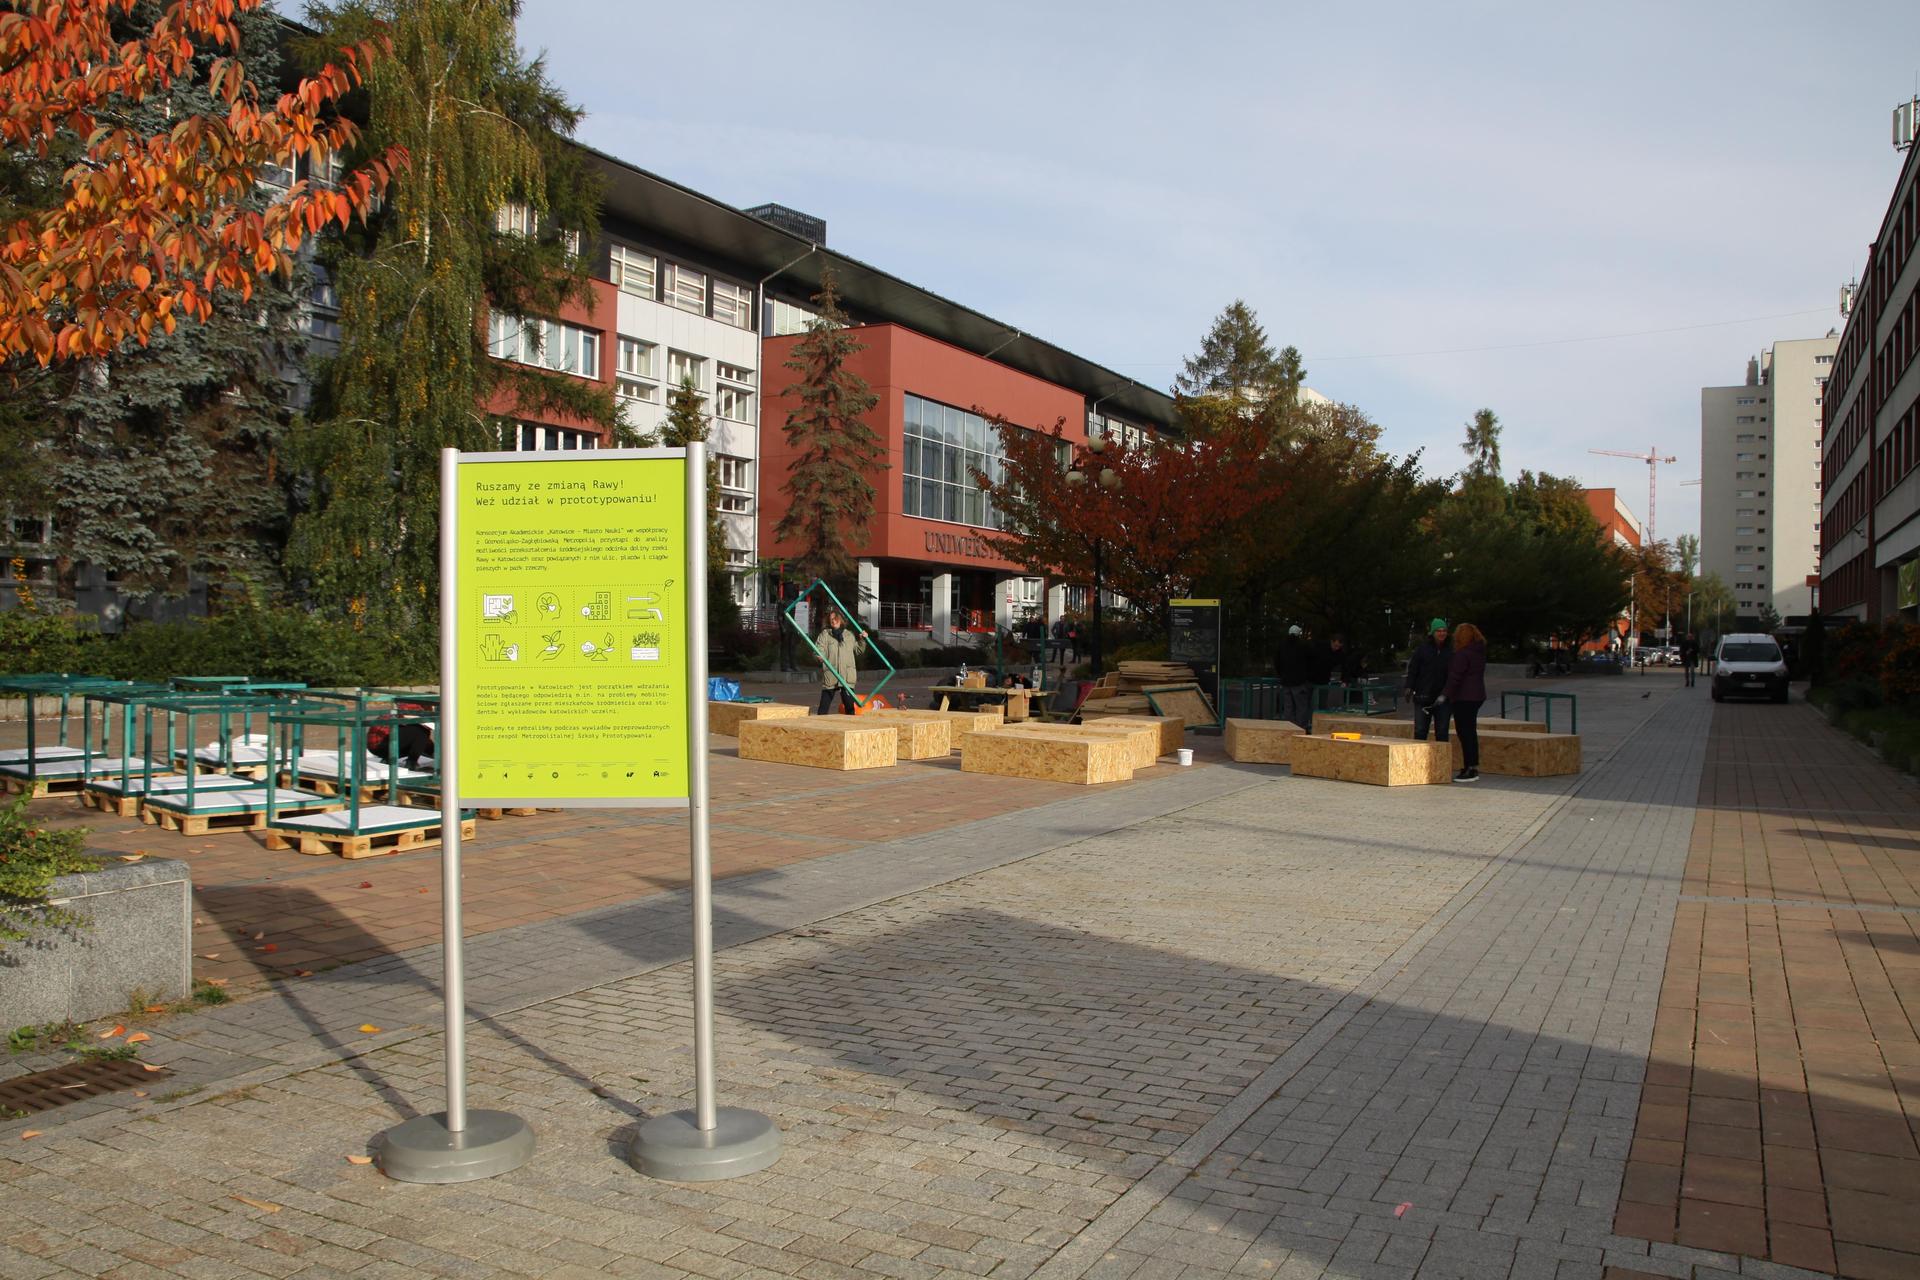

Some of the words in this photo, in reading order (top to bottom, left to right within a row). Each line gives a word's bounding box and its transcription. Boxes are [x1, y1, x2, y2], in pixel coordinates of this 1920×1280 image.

[477, 482, 520, 492] Ruszamy
[528, 482, 540, 490] ze
[547, 480, 585, 491] zmianą
[593, 480, 624, 490] Rawy!
[476, 496, 495, 506] Weź
[502, 496, 539, 505] udział
[560, 494, 657, 506] prototypowaniu!
